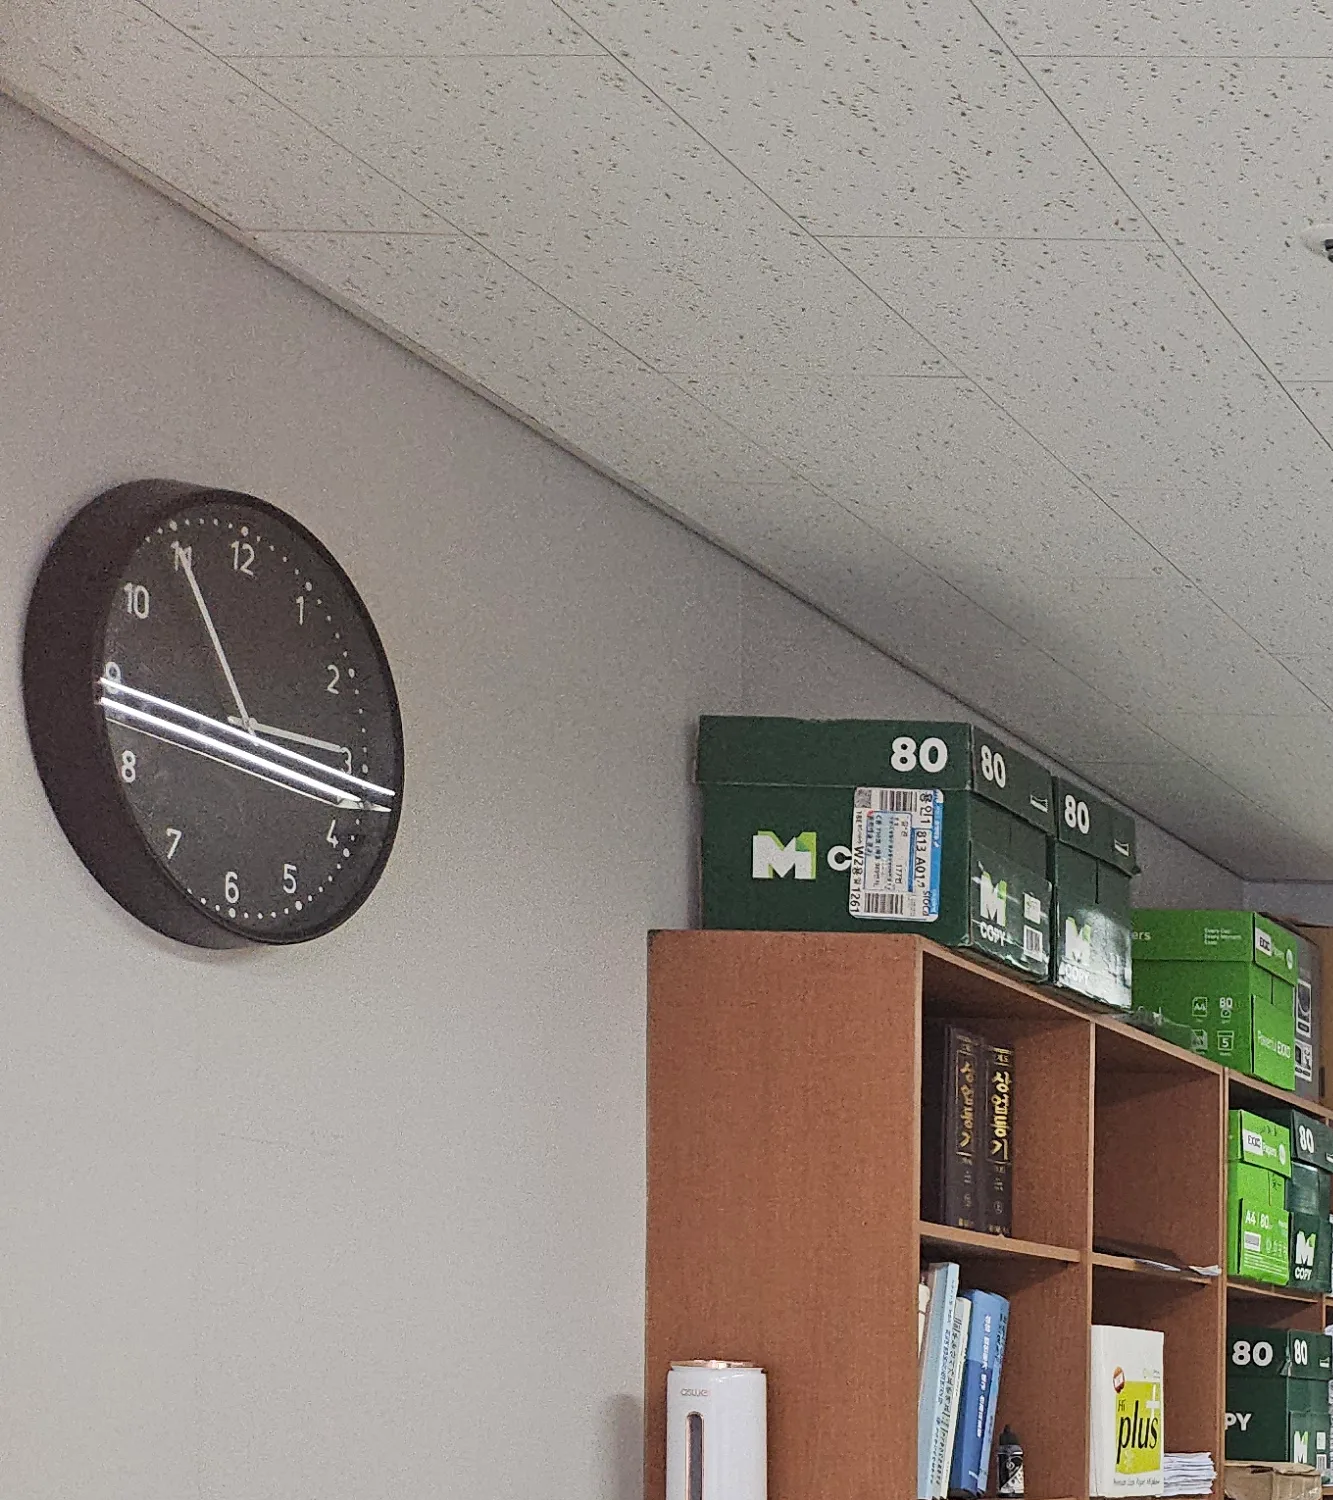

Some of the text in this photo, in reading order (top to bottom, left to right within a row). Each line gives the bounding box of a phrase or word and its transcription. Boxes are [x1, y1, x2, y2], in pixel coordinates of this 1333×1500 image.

[231, 541, 255, 577] 12
[123, 583, 150, 619] 10
[296, 596, 305, 626] 1
[327, 665, 340, 694] 2
[121, 750, 136, 783] 8
[890, 737, 948, 773] 80
[980, 744, 1006, 788] 80
[1064, 794, 1090, 835] 80
[166, 828, 182, 859] 7
[326, 819, 338, 849] 4
[224, 871, 240, 904] 6
[283, 864, 299, 894] 5
[979, 921, 1007, 947] COPY
[1220, 997, 1233, 1009] 80
[1299, 1125, 1315, 1154] 80
[1245, 1208, 1256, 1226] A4
[1294, 1266, 1313, 1281] COPY
[1232, 1340, 1273, 1367] 80
[1294, 1339, 1308, 1366] 80
[1116, 1400, 1158, 1464] plus
[1224, 1412, 1252, 1431] PY
